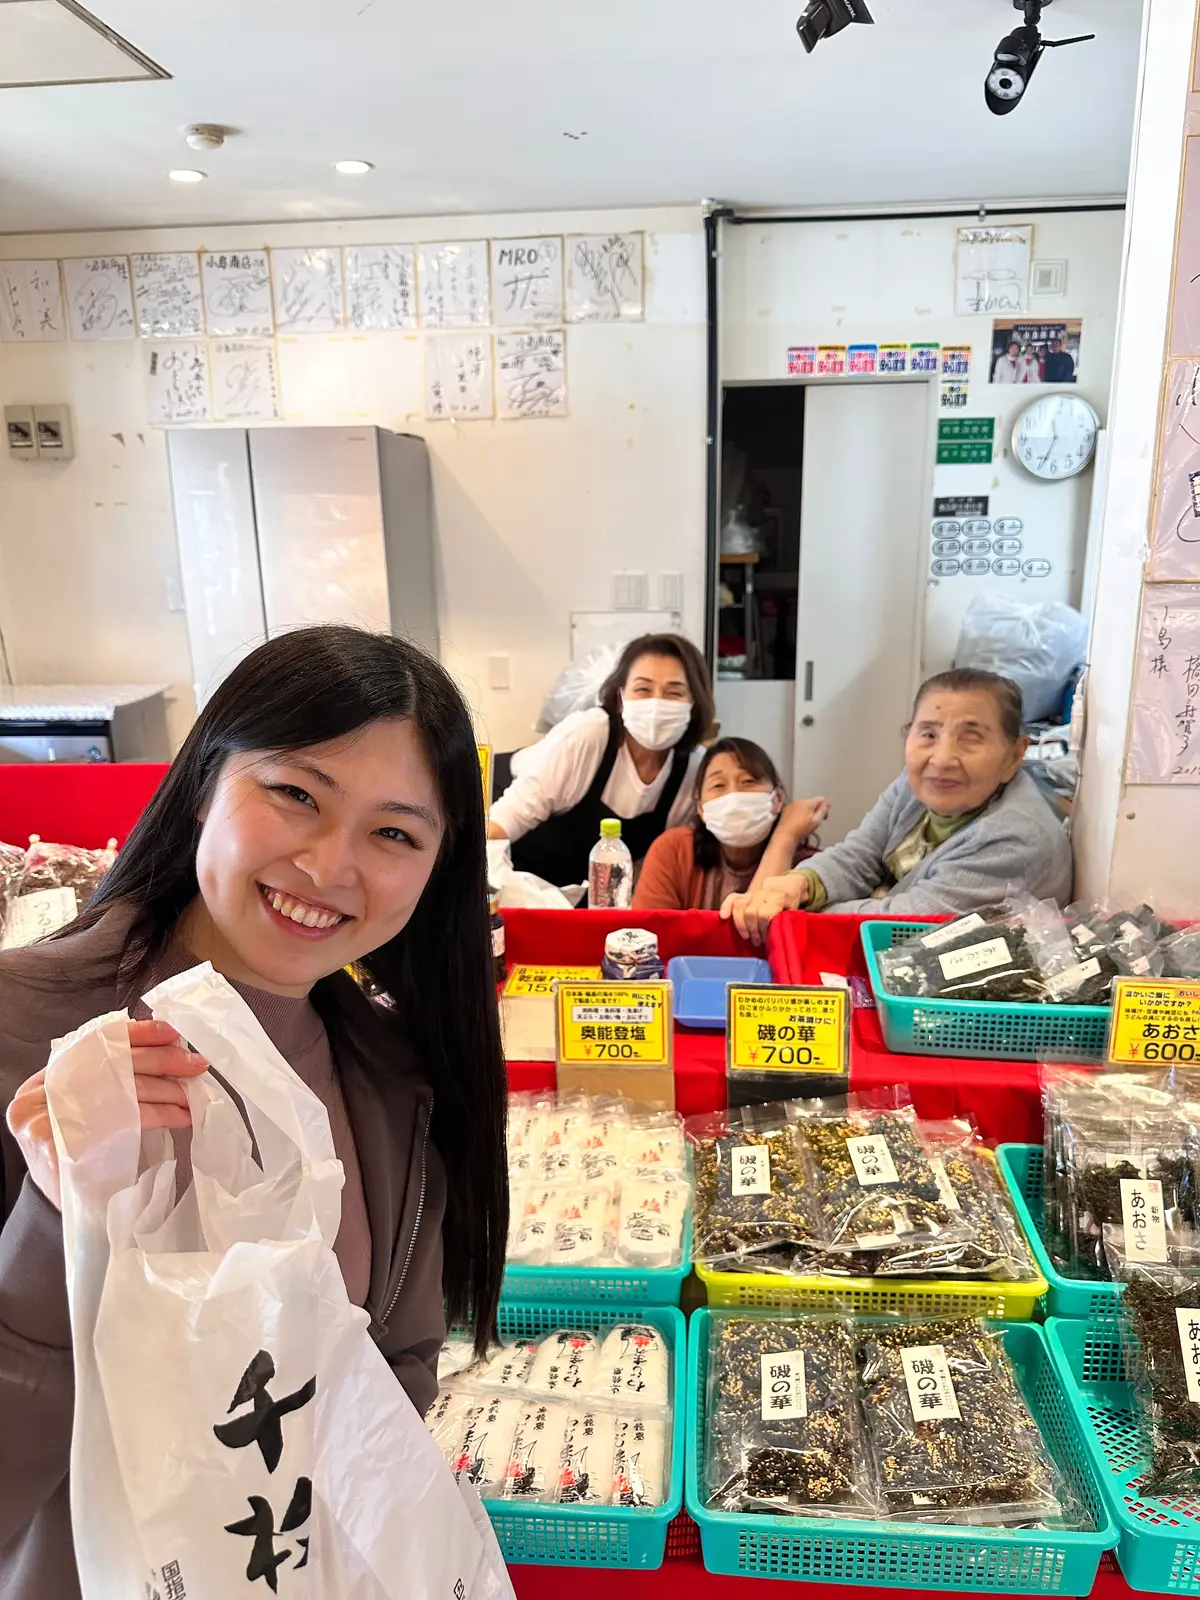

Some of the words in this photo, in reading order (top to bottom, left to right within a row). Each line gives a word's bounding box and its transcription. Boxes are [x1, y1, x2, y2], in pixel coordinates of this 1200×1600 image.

[498, 248, 538, 267] MRO
[1025, 447, 1032, 461] 8
[1050, 460, 1058, 475] 6
[581, 1025, 646, 1041] 奥能登塩
[758, 1024, 815, 1042] 磯の華
[1142, 1023, 1200, 1041] あおさ
[1131, 1189, 1146, 1250] あおさ
[770, 1364, 792, 1410] 磯の華
[911, 1359, 943, 1409] 磯の華
